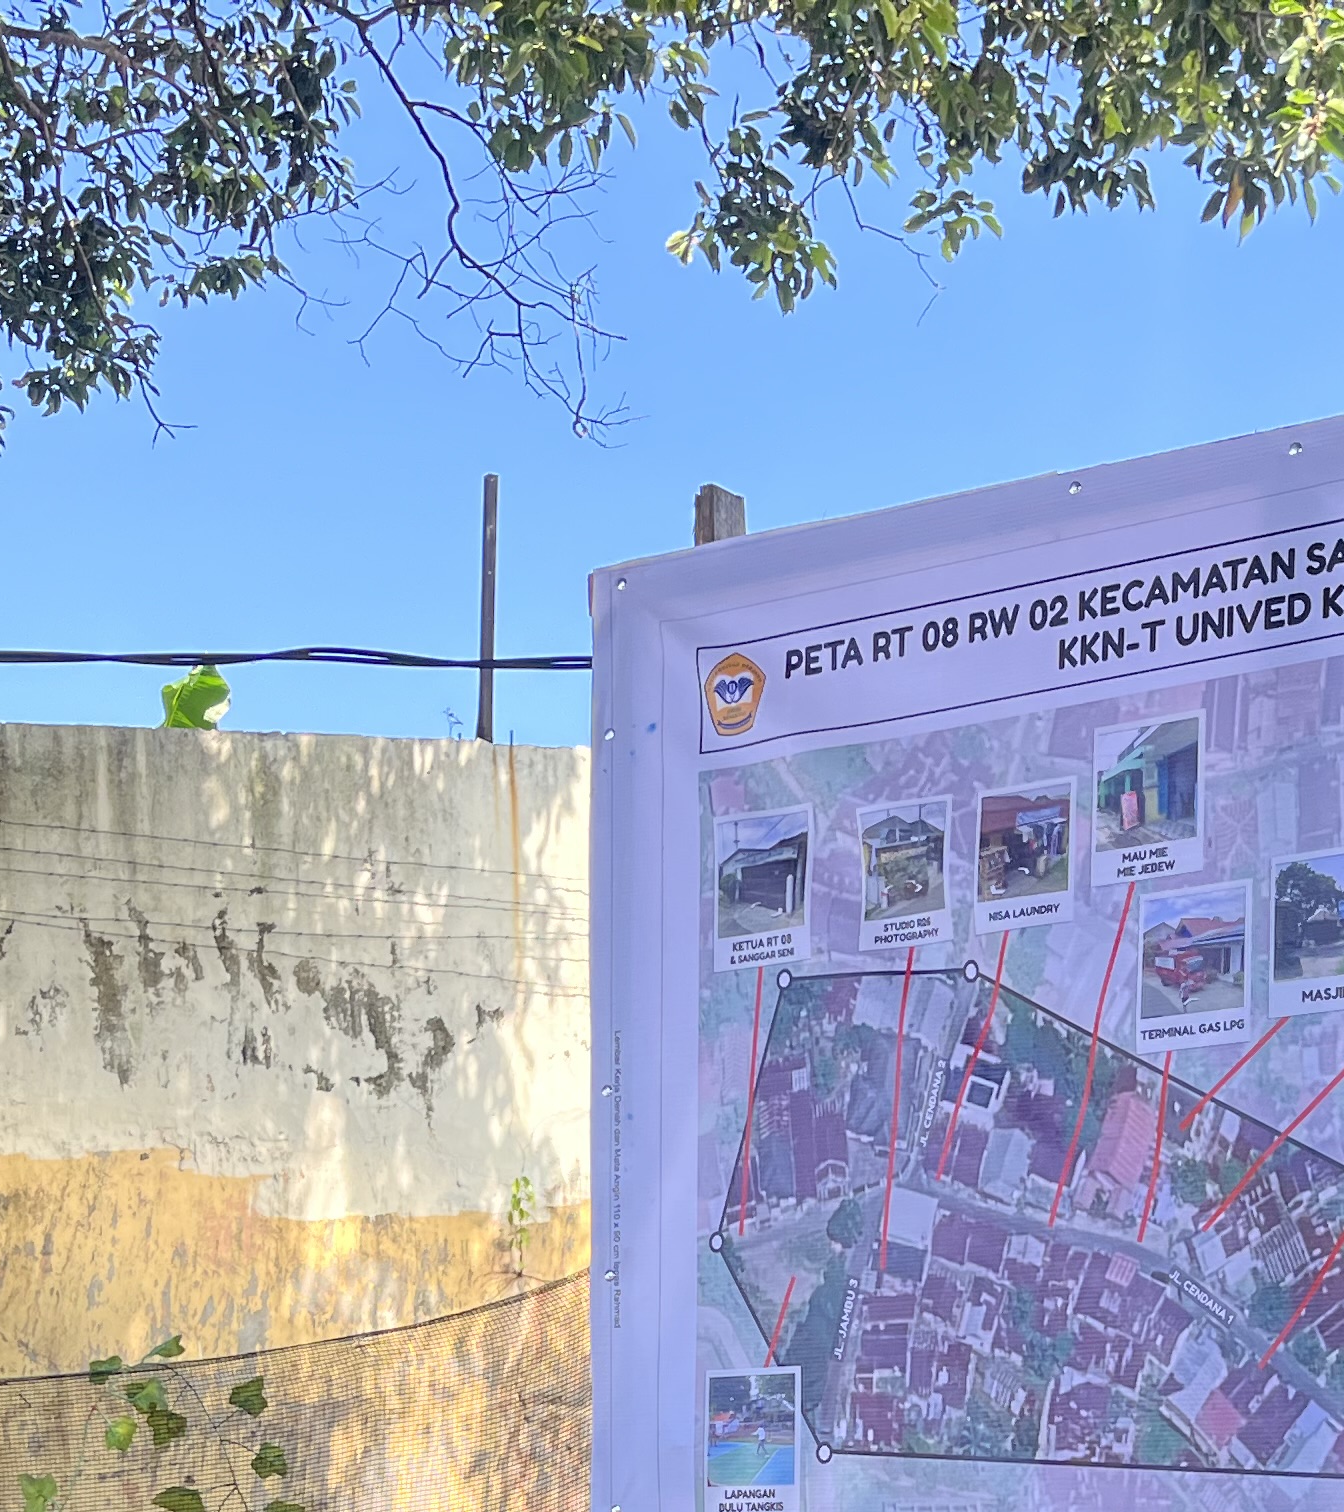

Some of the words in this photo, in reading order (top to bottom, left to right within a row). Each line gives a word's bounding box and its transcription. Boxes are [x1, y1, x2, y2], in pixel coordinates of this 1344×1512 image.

[785, 637, 863, 679] PETA
[873, 625, 914, 662] RT
[922, 617, 959, 652] 08
[969, 604, 1020, 643] RW
[1029, 595, 1068, 631] 02
[1078, 548, 1295, 621] KECAMATAN
[1059, 619, 1166, 670] KKN-T
[1176, 592, 1311, 646] UNIVED
[1122, 850, 1147, 863] MAU
[1149, 847, 1168, 859] MIE
[1117, 866, 1136, 878] MIE
[989, 910, 1010, 921] NISA
[1013, 903, 1060, 918] LAUNDRY
[883, 920, 915, 932] STUDIO
[732, 938, 765, 952] KETUA
[767, 936, 779, 947] RT
[781, 933, 792, 945] 08
[874, 928, 939, 944] PHOTOGRAPHY
[738, 950, 776, 964] SANGGAR
[777, 947, 794, 958] SENI
[1140, 1025, 1196, 1040] TERMINAL
[1199, 1022, 1221, 1034] GAS
[1223, 1019, 1245, 1031] LPG
[725, 1489, 775, 1500] LAPANGAN
[745, 1501, 784, 1512] TANGKIS
